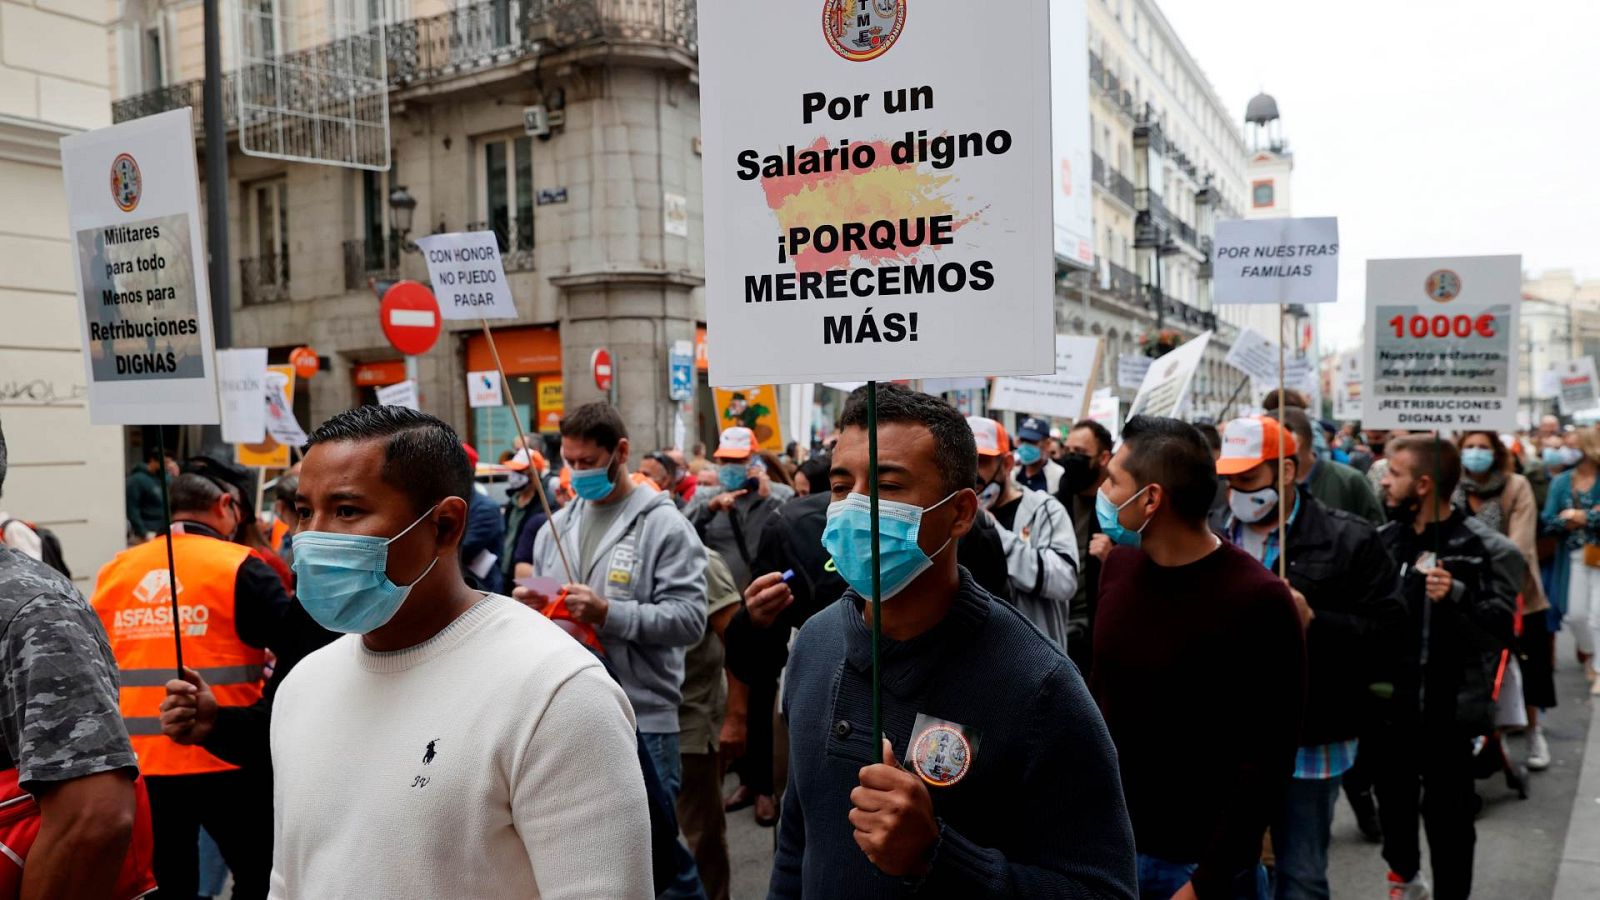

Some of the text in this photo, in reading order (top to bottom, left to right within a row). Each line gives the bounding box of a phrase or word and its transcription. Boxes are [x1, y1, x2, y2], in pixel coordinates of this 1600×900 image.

[802, 85, 934, 125] Por un
[736, 129, 1012, 181] Salario digno
[104, 225, 160, 246] Militares
[777, 214, 954, 264] ¡PORQUE
[429, 246, 495, 263] CON HONOR
[1217, 243, 1339, 259] POR NUESTRAS
[105, 254, 166, 280] para todo
[439, 269, 497, 285] NO PUEDO
[1241, 264, 1313, 278] FAMILIAS
[744, 260, 995, 304] MERECEMOS
[102, 285, 175, 307] Menos para
[453, 292, 495, 307] PAGAR
[90, 317, 198, 342] Retribuciones
[822, 307, 919, 344] MÁS!
[1389, 314, 1495, 338] 1000€
[115, 351, 177, 376] DIGNAS
[1380, 350, 1500, 361] Nuestro esfuerzo
[1383, 367, 1495, 379] no puede seguir
[1385, 384, 1496, 395] sin recompensa
[1378, 400, 1502, 411] ¡RETRIBUCIONES
[1397, 413, 1481, 424] DIGNAS YA!
